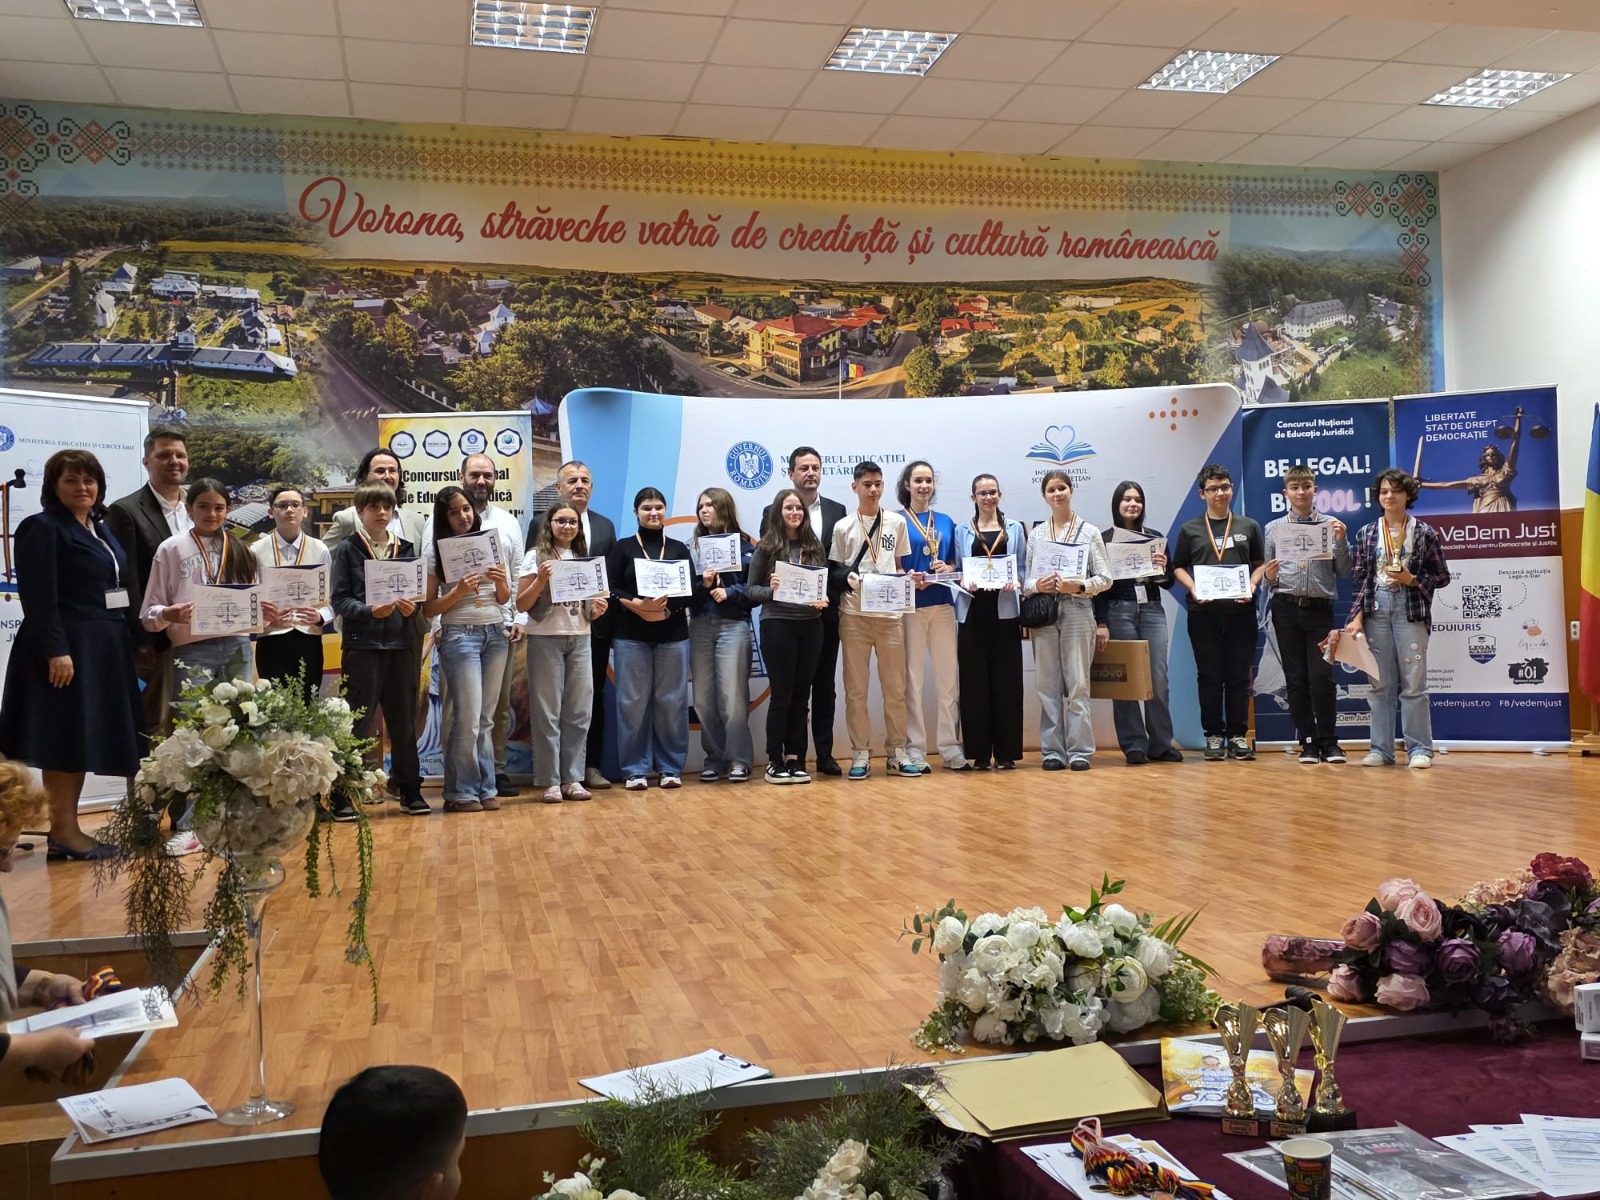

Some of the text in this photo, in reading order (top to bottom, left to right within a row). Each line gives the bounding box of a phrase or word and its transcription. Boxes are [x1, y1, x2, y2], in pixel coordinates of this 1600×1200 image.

[299, 176, 1220, 265] Vorona, străveche vatră de credință și cultură românească
[1277, 417, 1354, 429] Concursul Național
[1425, 411, 1477, 423] LIBERTATE
[1425, 419, 1498, 432] STAT DE DREPT
[1275, 428, 1354, 439] de Educație Juridică
[1426, 431, 1488, 442] DEMOCRAȚIE
[780, 454, 847, 465] MERUL
[1313, 489, 1361, 514] OOL
[1440, 522, 1557, 542] VeDem Just
[1430, 699, 1490, 709] .vedemjust.ro
